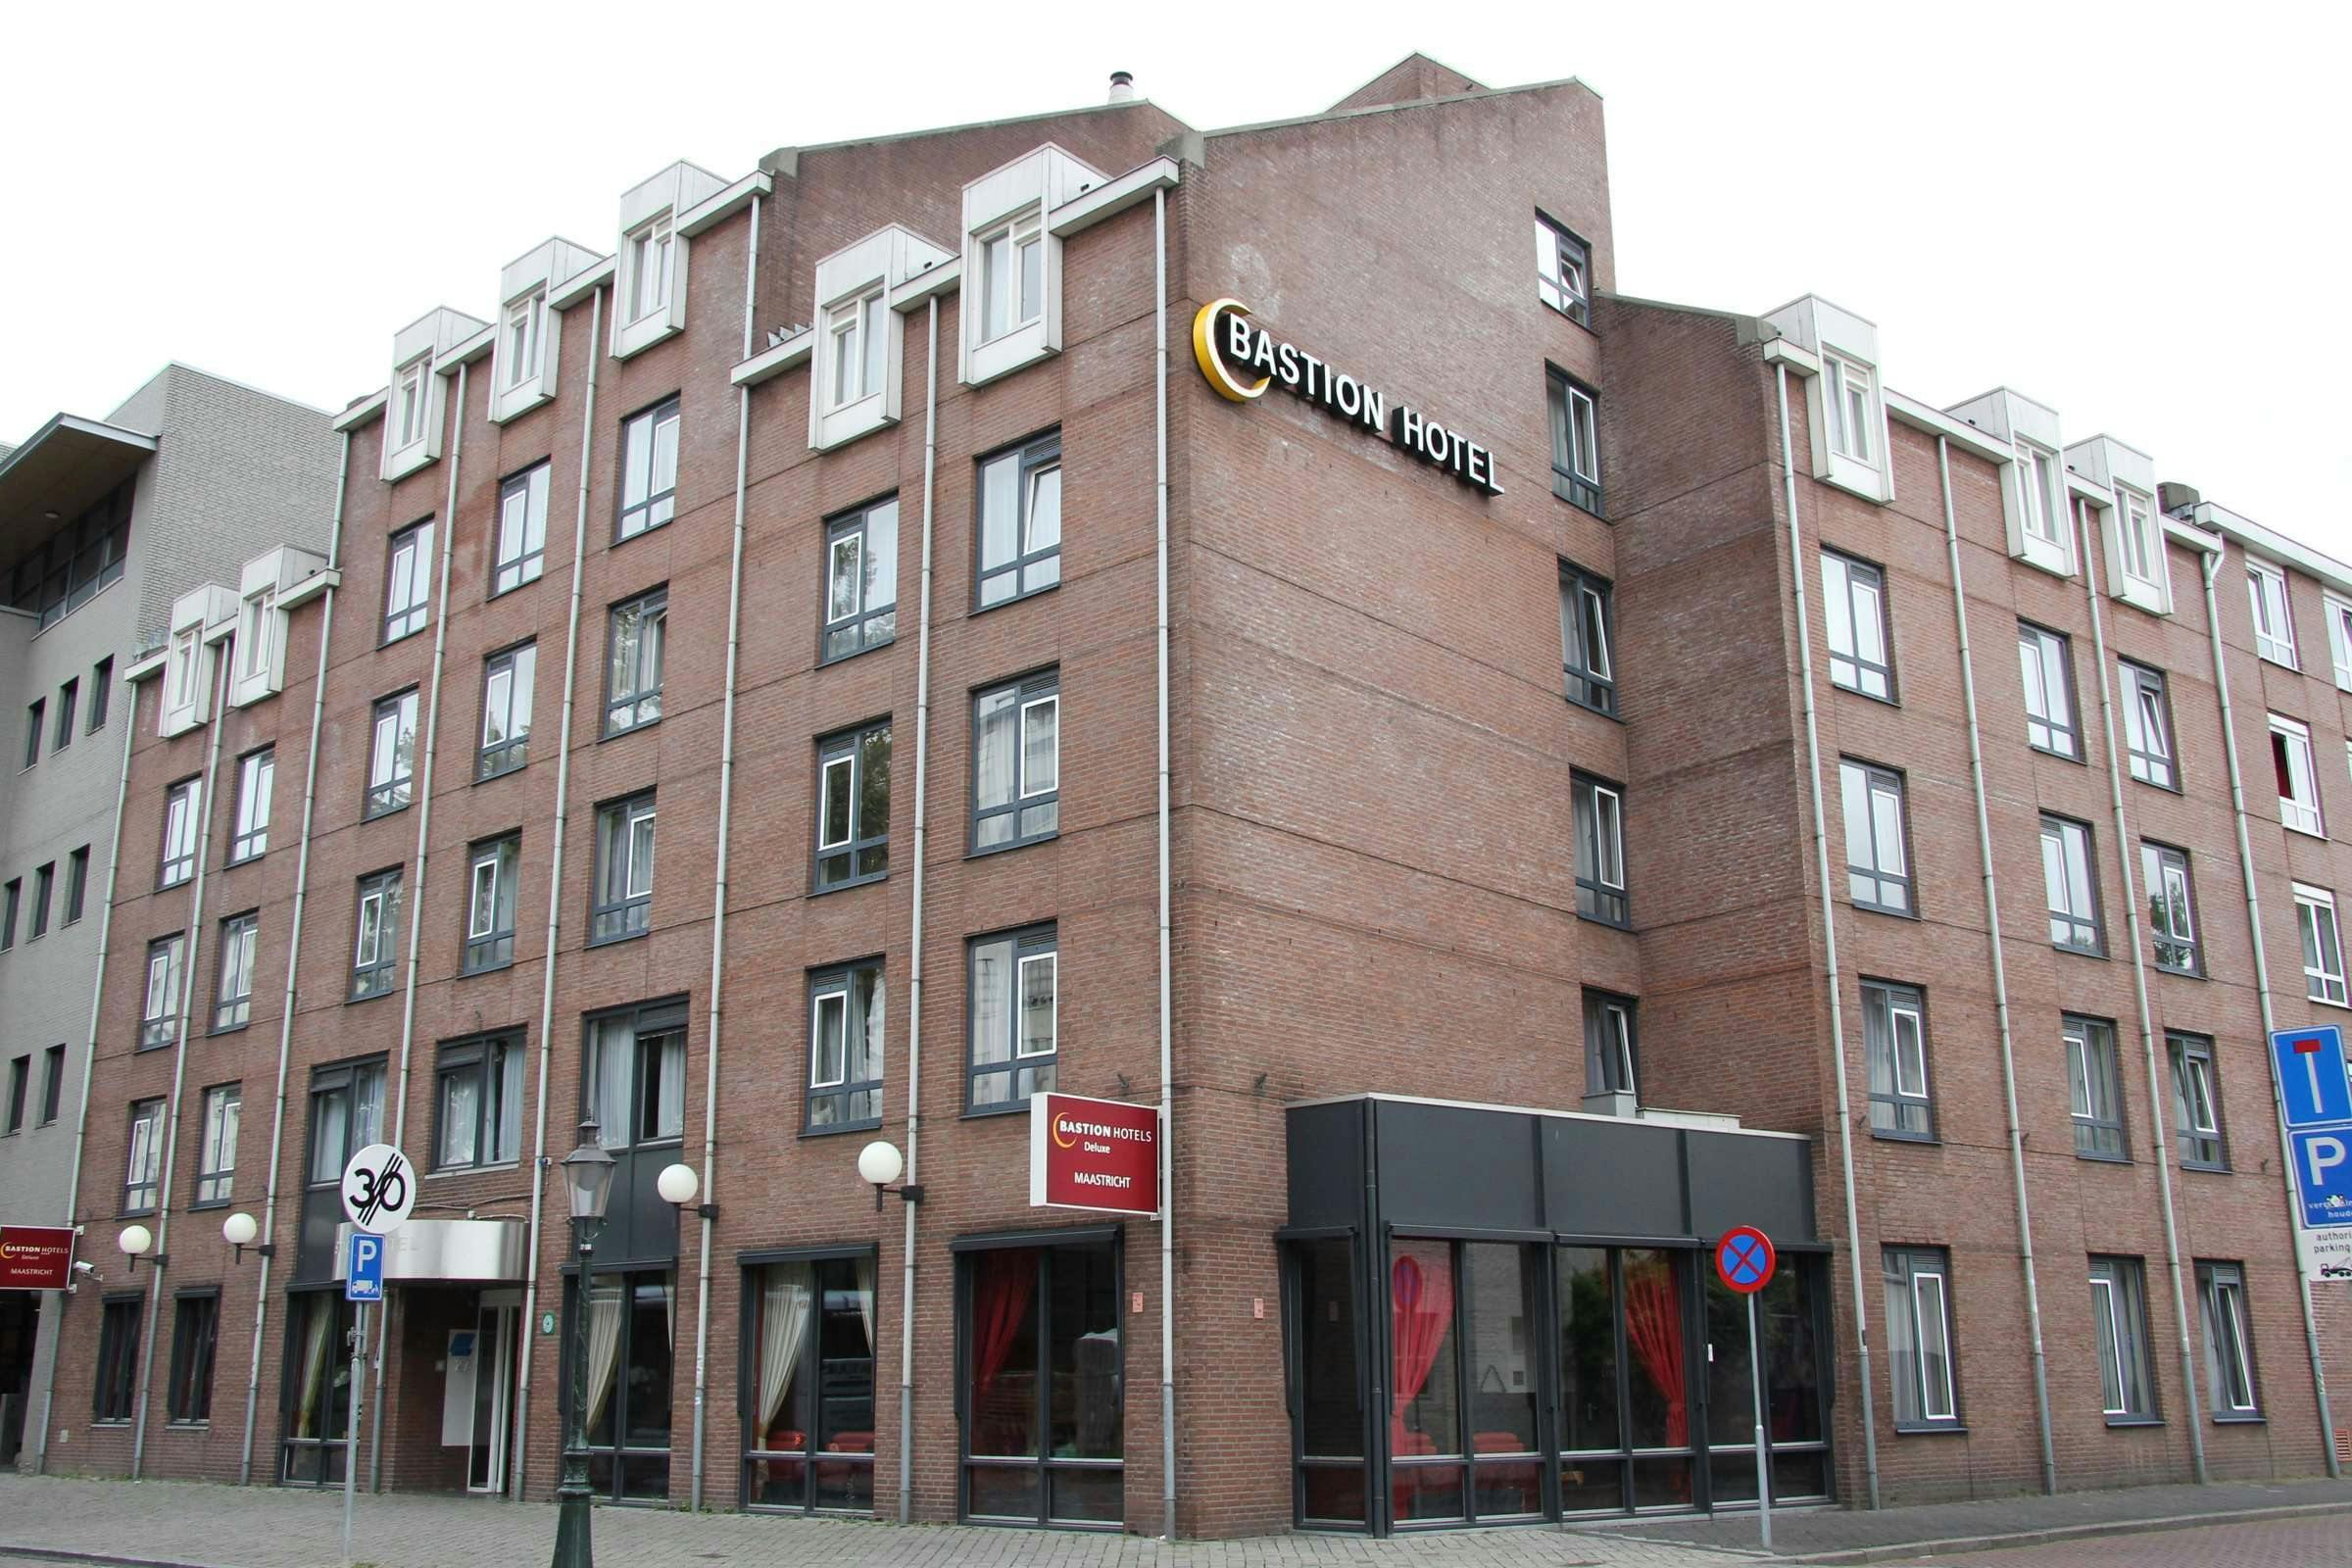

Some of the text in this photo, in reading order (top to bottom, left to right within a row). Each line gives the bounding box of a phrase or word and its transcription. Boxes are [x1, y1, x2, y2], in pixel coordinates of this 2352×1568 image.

[1228, 312, 1504, 496] BASTION HOTEL
[1059, 1120, 1152, 1143] BASTION HOTELS
[1084, 1141, 1111, 1154] Deluxe
[349, 1167, 407, 1212] 30
[1074, 1171, 1132, 1189] MAASTRICHT
[357, 1239, 377, 1273] P
[2313, 1244, 2351, 1254] parking
